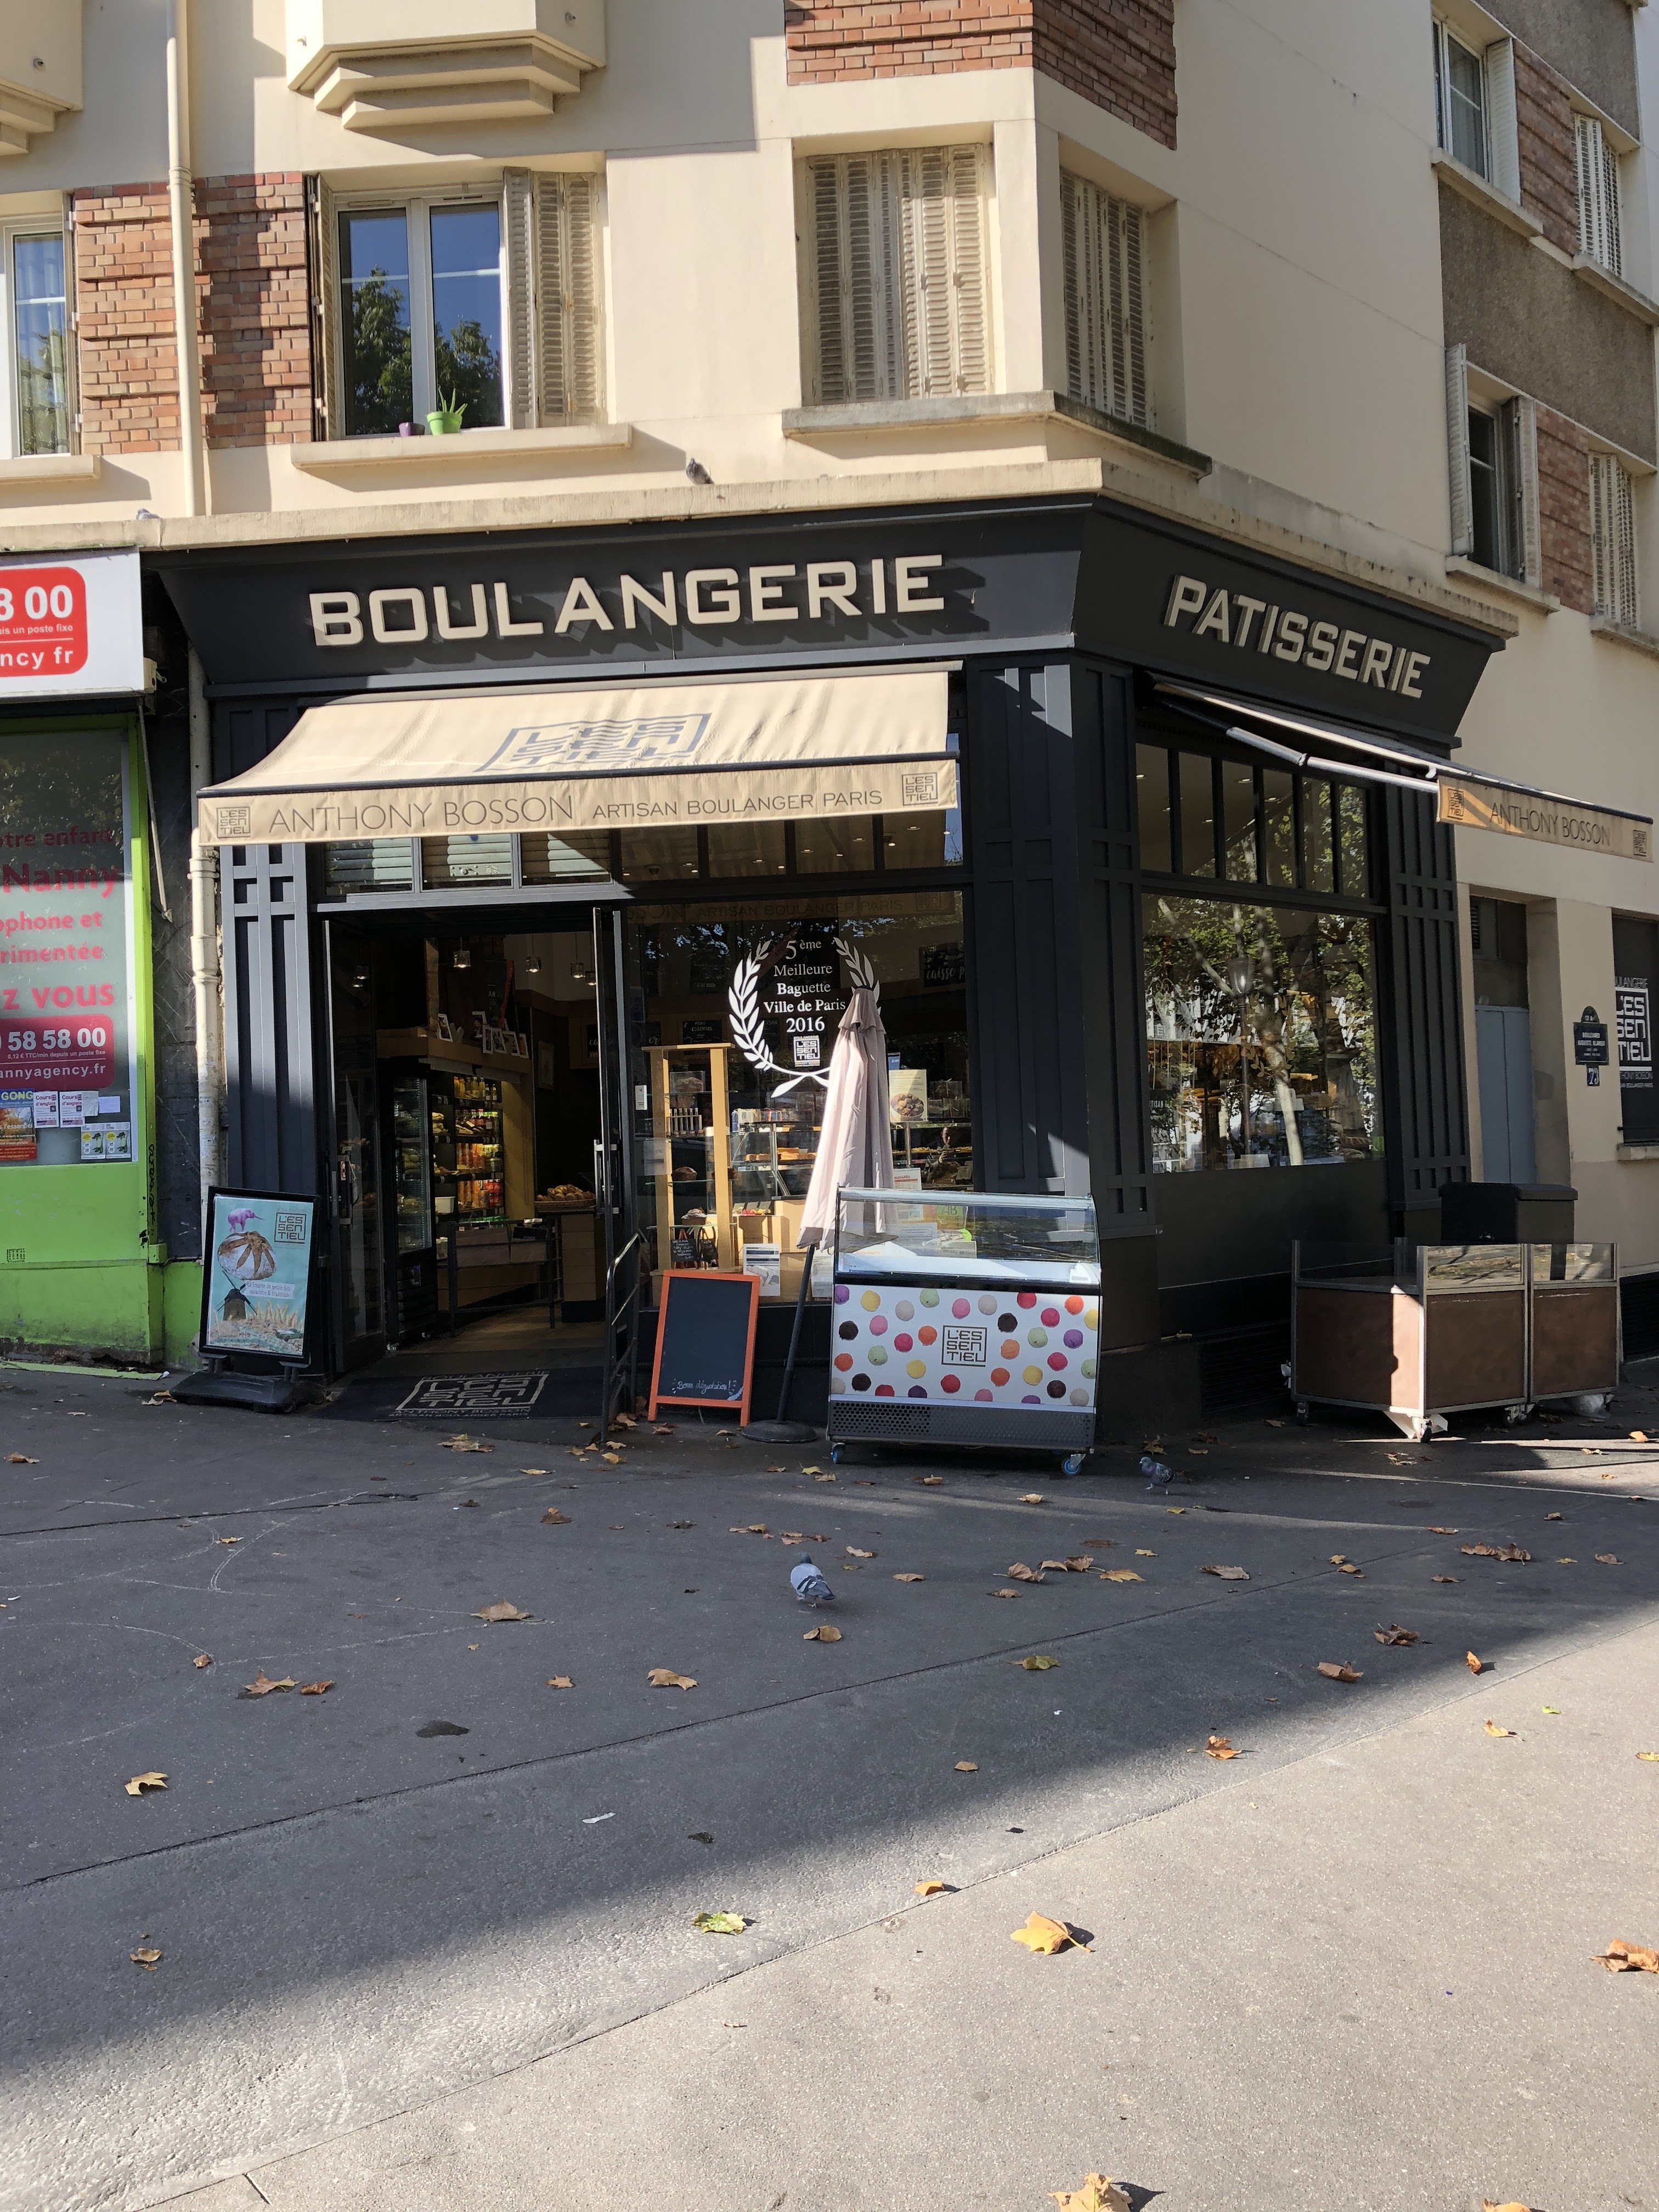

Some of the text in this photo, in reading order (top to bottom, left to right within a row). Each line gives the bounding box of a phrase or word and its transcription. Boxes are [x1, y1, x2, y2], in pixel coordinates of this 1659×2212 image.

[25, 585, 73, 619] 00
[308, 554, 945, 647] BOULANGERIE
[27, 625, 54, 635] poste
[56, 623, 74, 632] fixe
[1163, 574, 1431, 699] PATISSERIE
[269, 790, 883, 833] ANTHONY BOSSON ARTISAN BOULANGER PARIS
[1490, 803, 1610, 846] ANTHONY BOSSON
[44, 825, 116, 846] enfant
[2, 863, 120, 898] Nanny
[80, 911, 103, 928] et
[774, 963, 833, 977] Meilleure
[31, 983, 114, 1009] vous
[777, 983, 831, 997] Baguette
[763, 998, 846, 1014] Ville de Paris
[786, 1017, 825, 1033] 2016
[8, 1027, 106, 1051] 58 58 00
[50, 1051, 69, 1059] depuis
[78, 1049, 94, 1058] poste
[1588, 1068, 1599, 1085] 73
[1, 1091, 33, 1101] GONG
[947, 1329, 983, 1340] L'ES
[946, 1351, 986, 1362] TIEL
